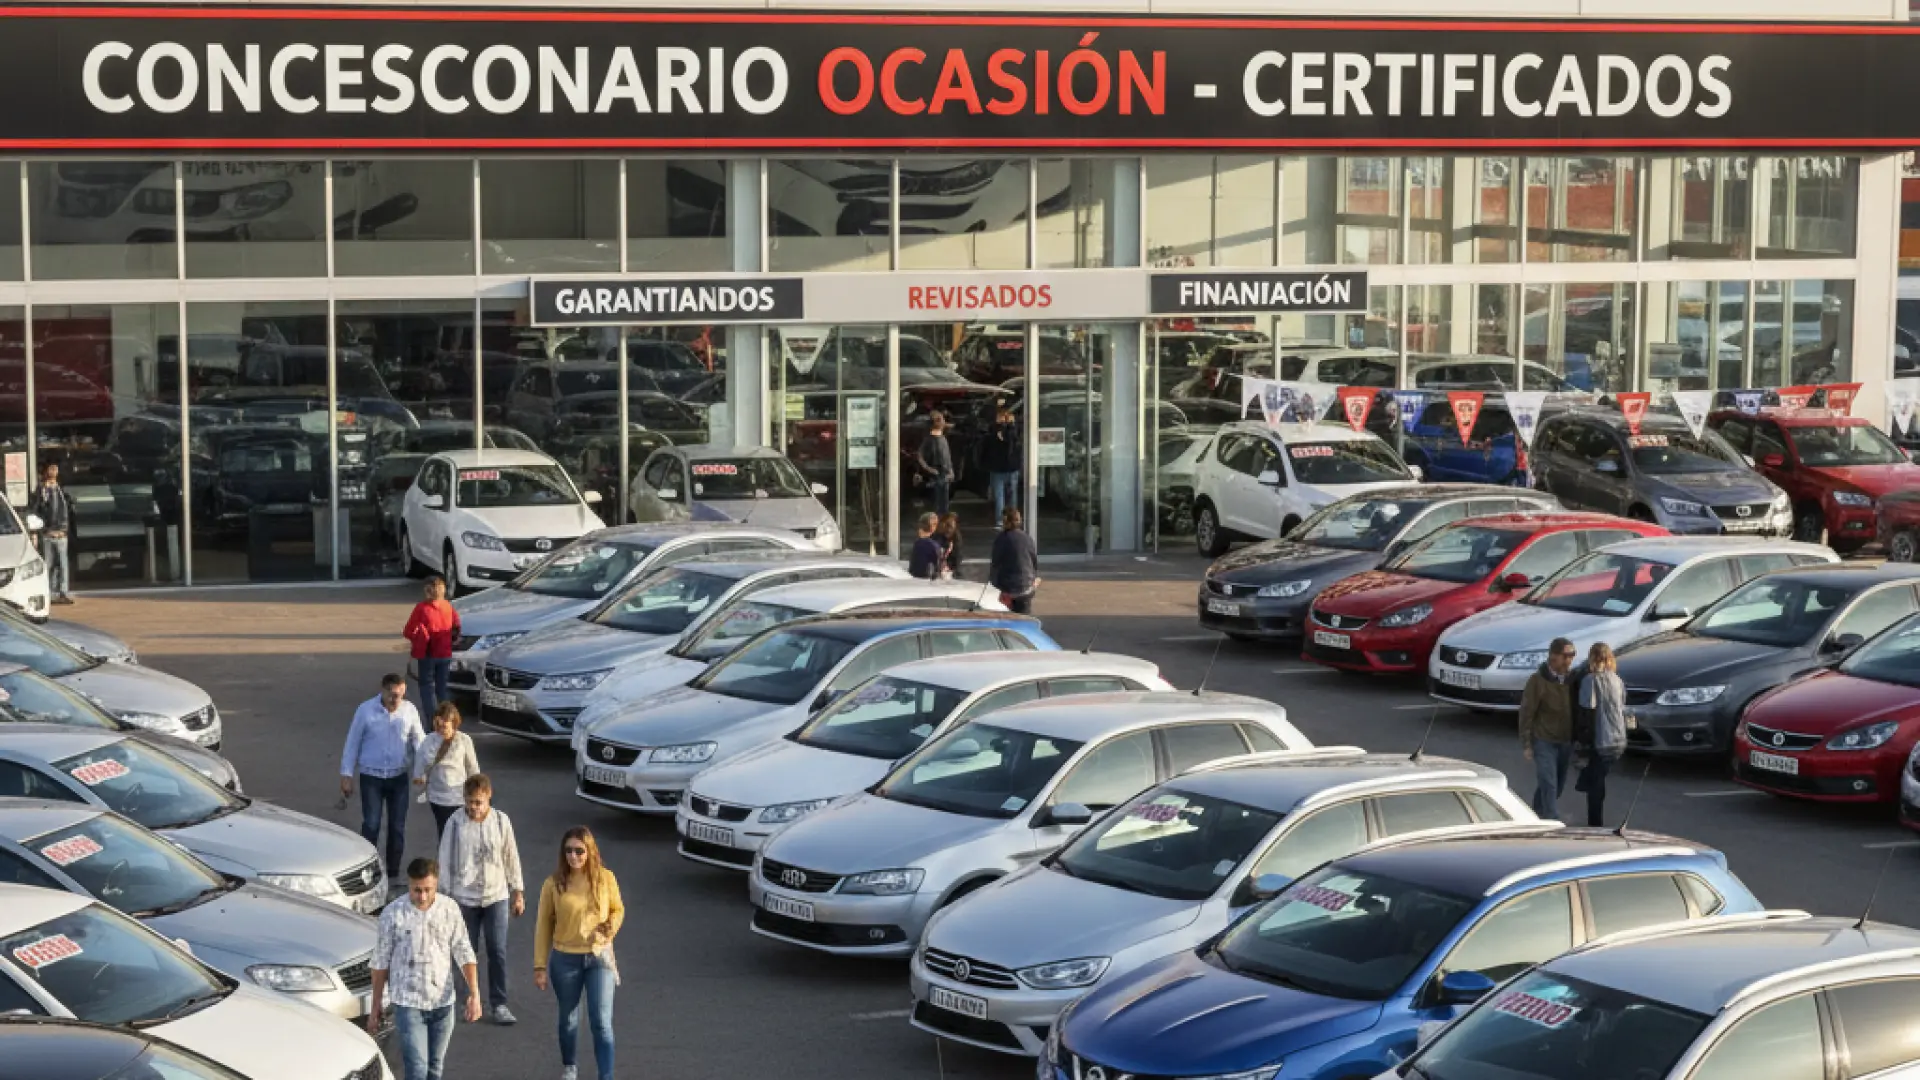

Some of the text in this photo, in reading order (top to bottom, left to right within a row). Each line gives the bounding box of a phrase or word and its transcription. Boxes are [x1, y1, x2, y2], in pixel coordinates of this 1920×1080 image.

[82, 40, 789, 117] CONCESCONARIO
[818, 31, 1168, 117] OCASIÓN
[1242, 50, 1732, 119] CERTIFICADOS
[555, 286, 775, 314] GARANTIANDOS
[908, 284, 1052, 310] REVISADOS
[1179, 273, 1351, 305] FINANIACIÓN
